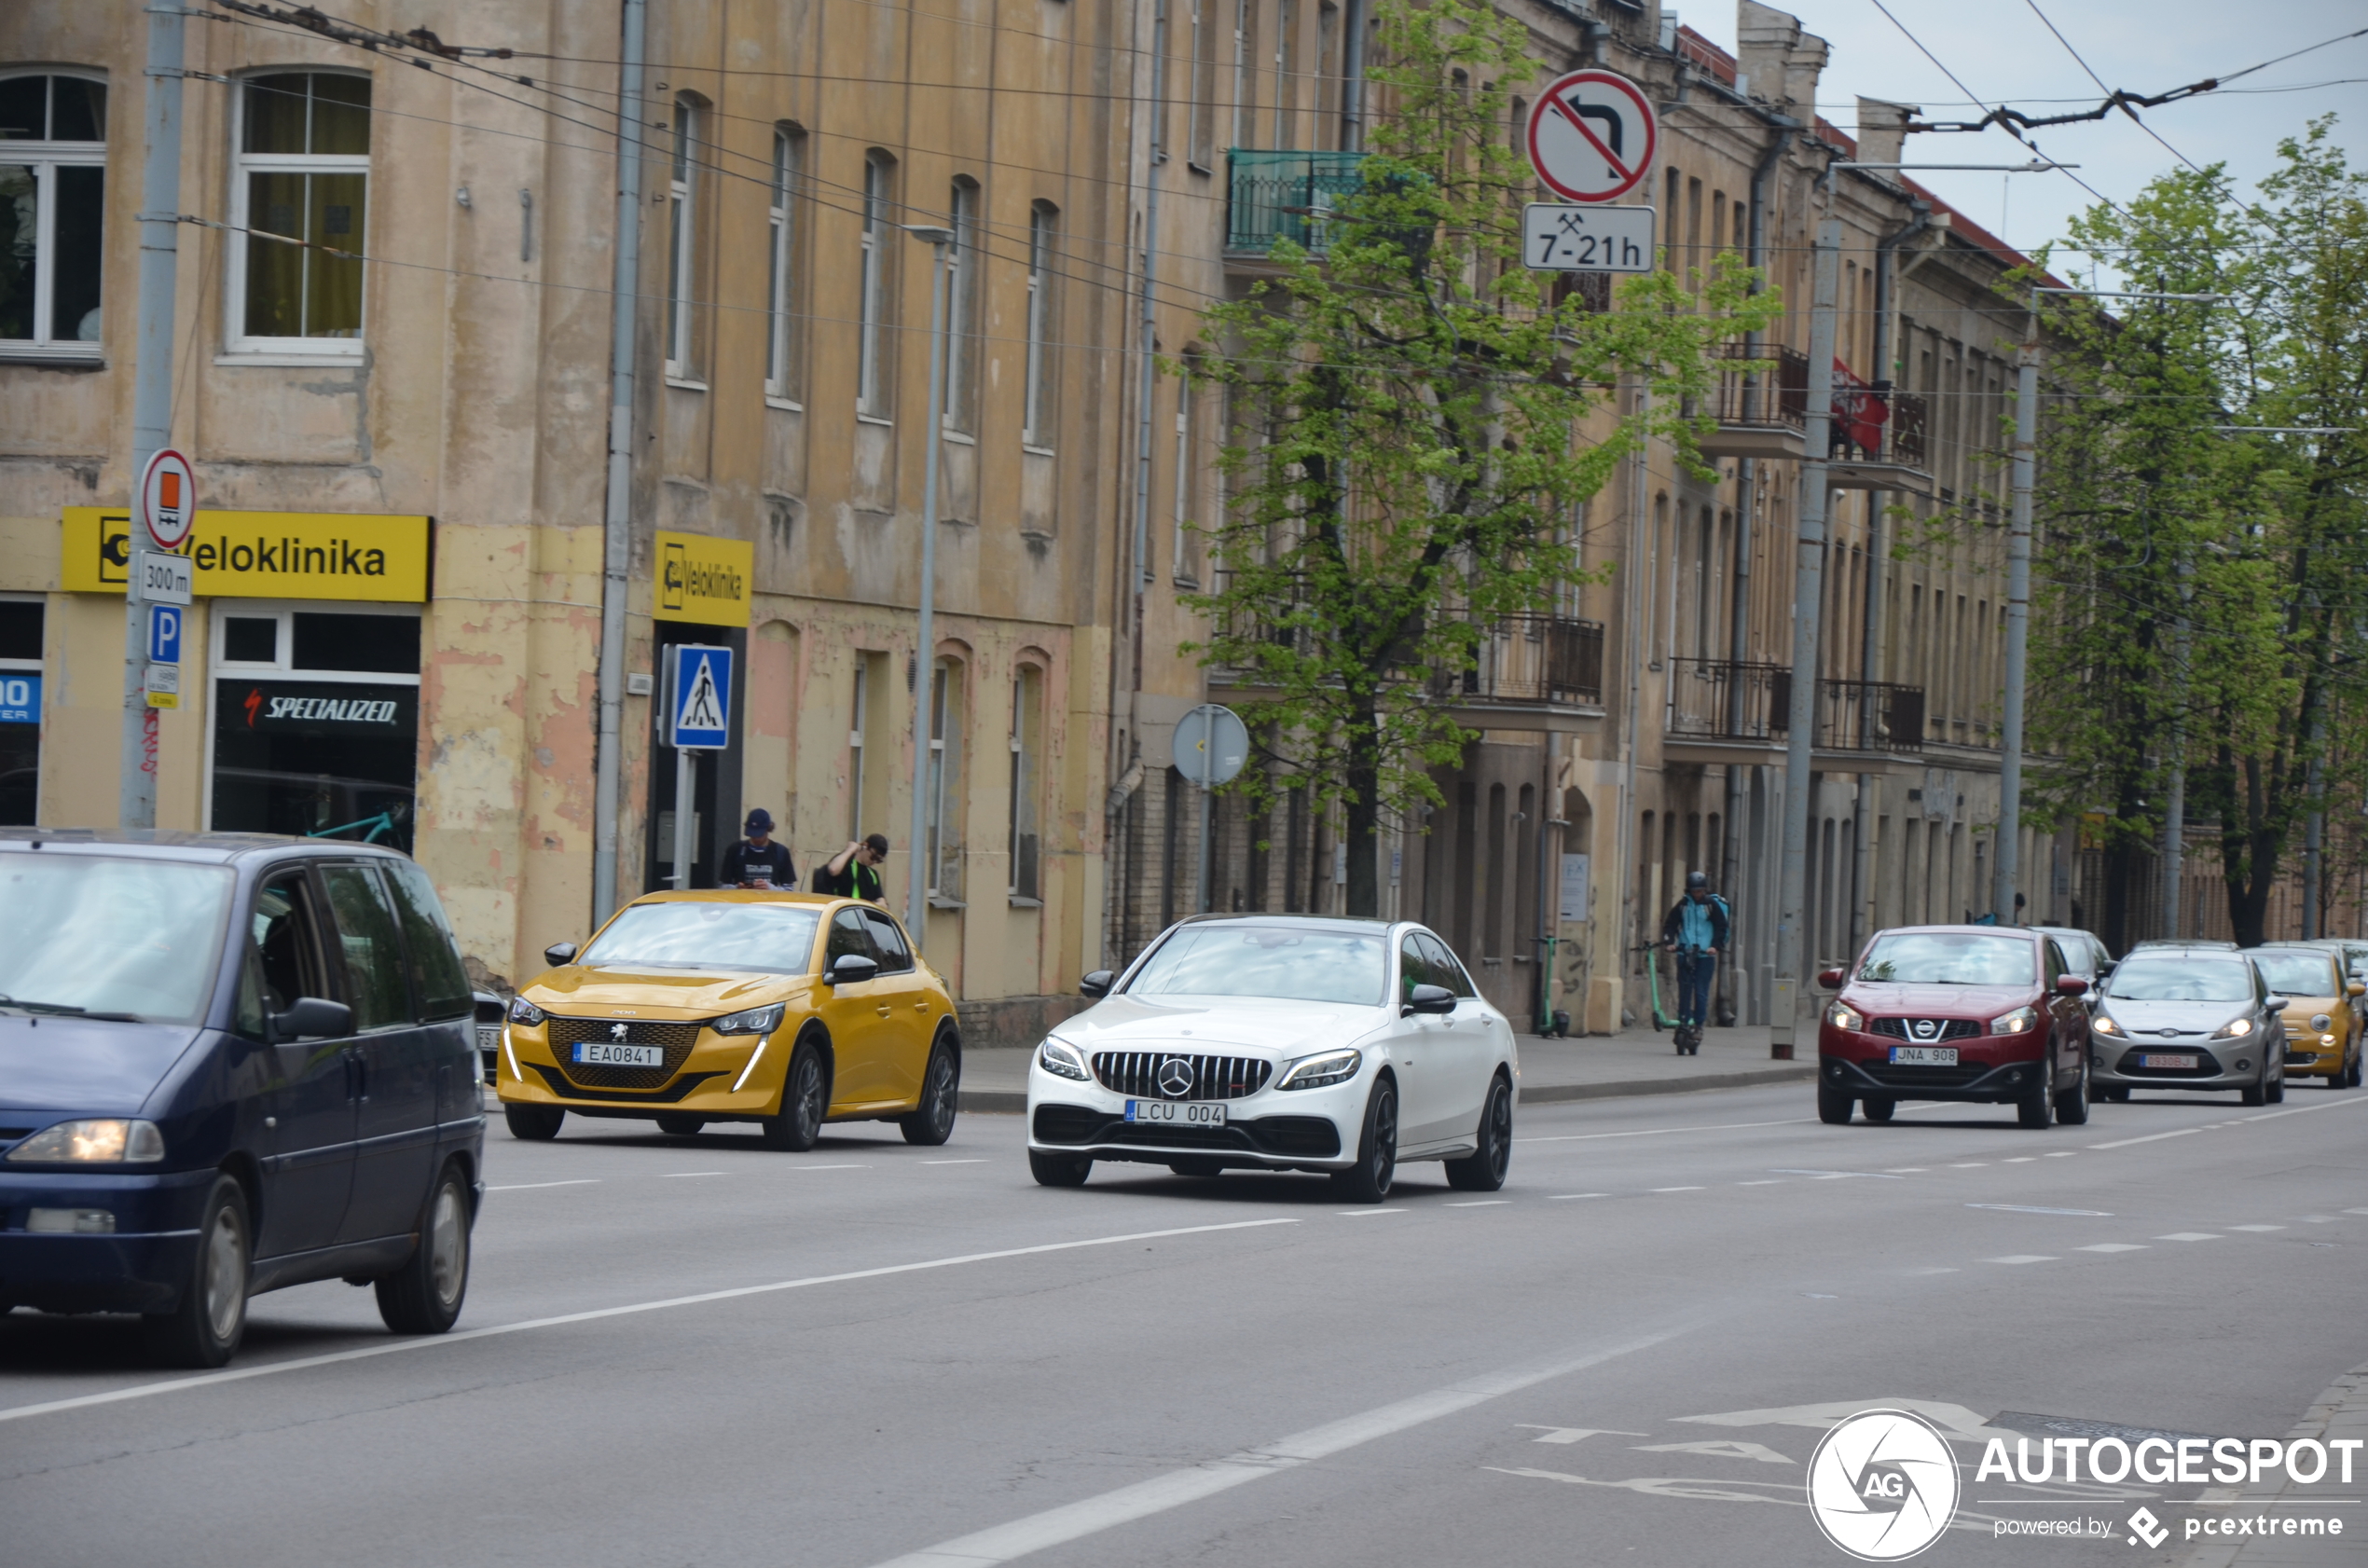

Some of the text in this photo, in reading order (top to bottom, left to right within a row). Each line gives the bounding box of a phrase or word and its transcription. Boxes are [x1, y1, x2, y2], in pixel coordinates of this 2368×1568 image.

[147, 565, 187, 592] 300 m
[683, 560, 741, 600] Veloklinika
[158, 612, 177, 656] P
[0, 710, 29, 720] ER
[265, 697, 398, 722] SPECIALIZED
[589, 1045, 652, 1064] EA0841
[1897, 1050, 1924, 1061] JNA
[1933, 1050, 1956, 1061] 908
[1136, 1103, 1221, 1123] LCU 004
